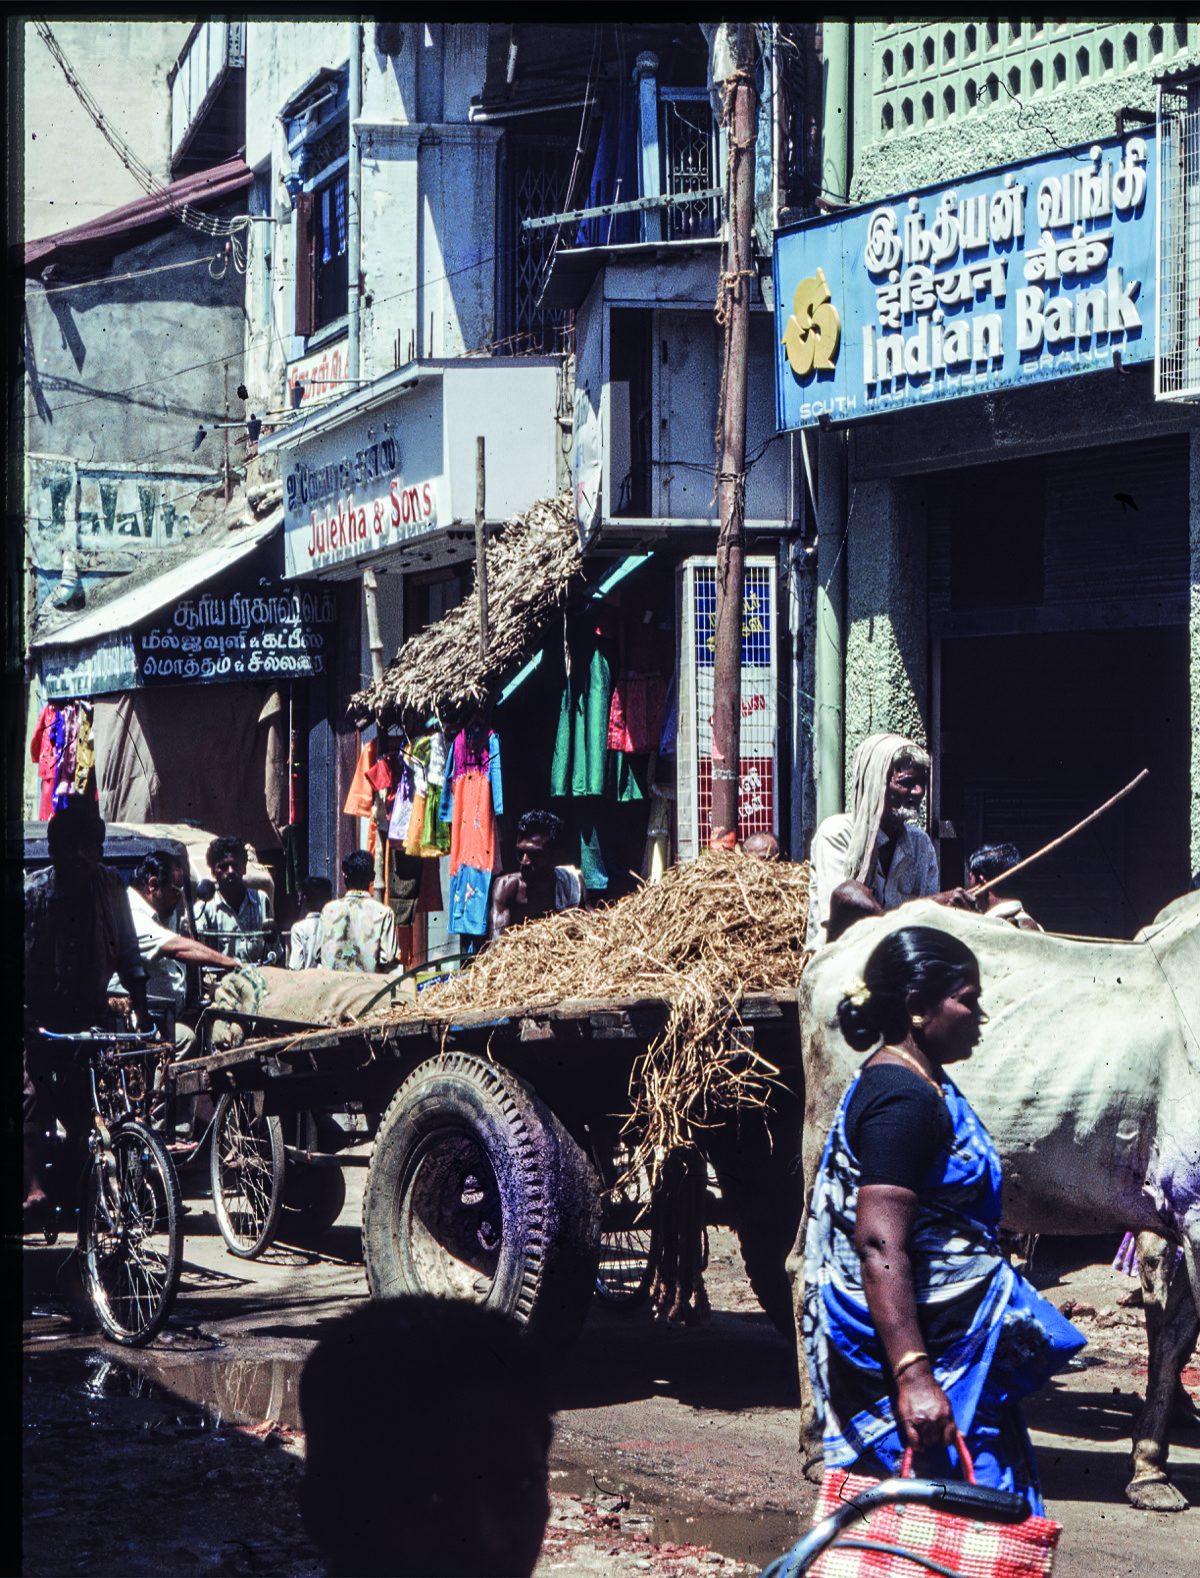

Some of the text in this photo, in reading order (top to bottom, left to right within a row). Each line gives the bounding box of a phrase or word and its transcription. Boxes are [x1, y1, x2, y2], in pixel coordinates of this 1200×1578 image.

[863, 137, 1147, 275] இந்தியன் வங்கி
[862, 266, 1143, 386] Indian Bank
[800, 397, 857, 420] SOUTH
[1023, 340, 1127, 374] BRANCH
[308, 480, 432, 557] Julekha & Sons
[142, 651, 231, 678] மொத்தம்
